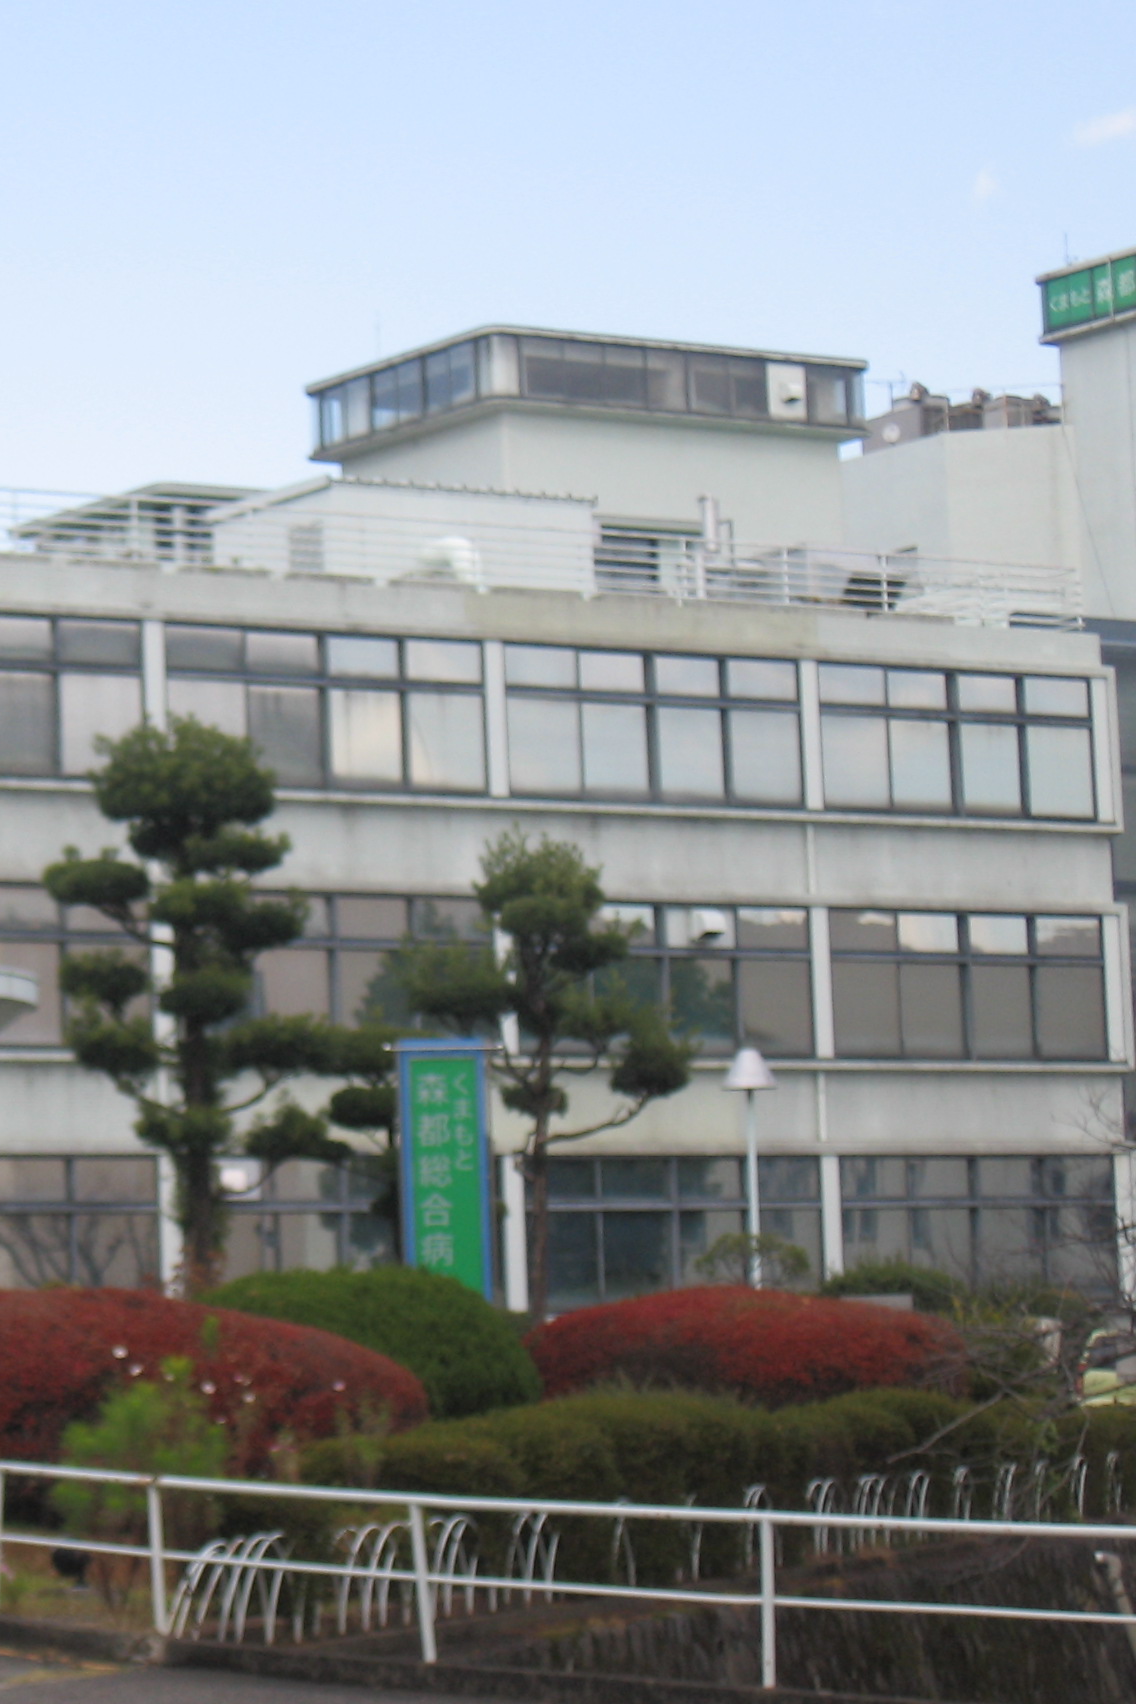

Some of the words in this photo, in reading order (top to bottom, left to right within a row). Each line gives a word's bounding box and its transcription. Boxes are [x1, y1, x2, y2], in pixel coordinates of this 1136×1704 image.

[416, 1073, 455, 1276] 森都総合病
[453, 1073, 475, 1171] くまもと
